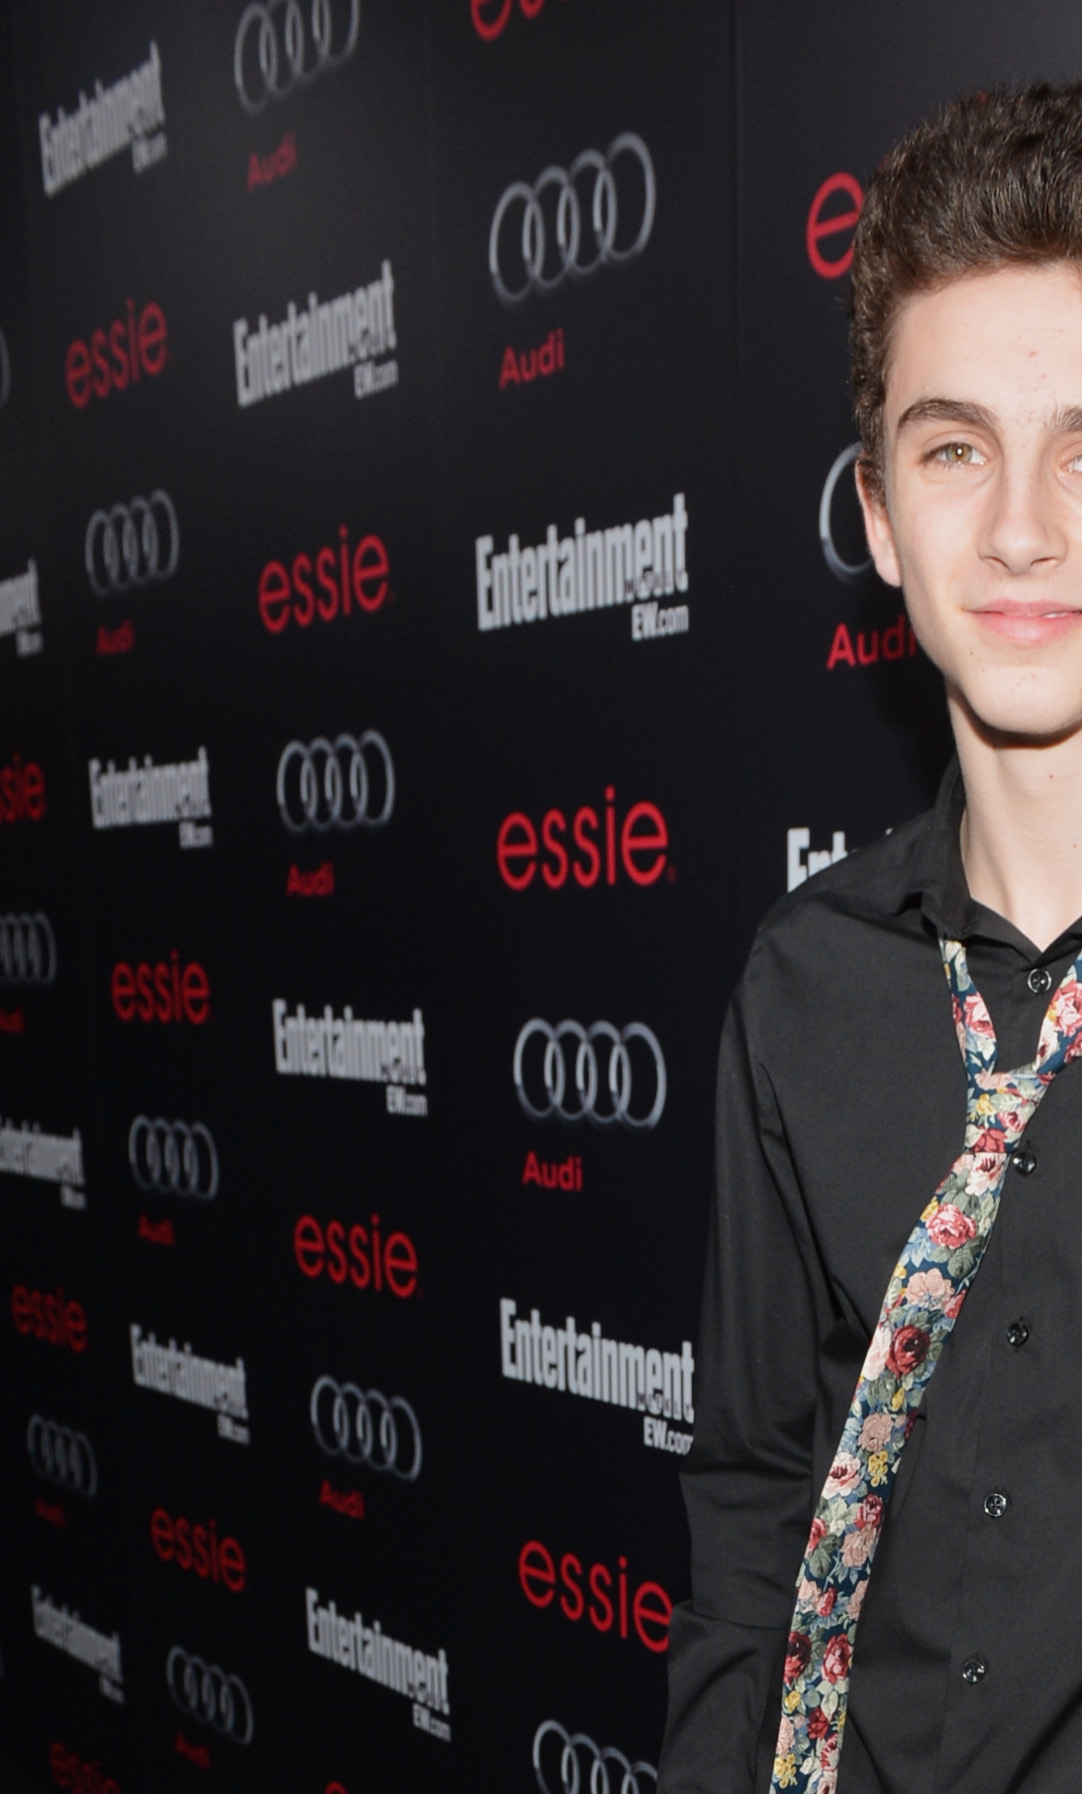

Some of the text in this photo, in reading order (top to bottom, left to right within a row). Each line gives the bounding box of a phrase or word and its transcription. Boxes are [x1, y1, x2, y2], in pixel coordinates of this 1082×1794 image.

[246, 133, 297, 191] Audi
[66, 298, 169, 408] essie
[500, 329, 565, 388] Audi
[258, 525, 389, 634] essie
[475, 493, 689, 631] Entertainment
[497, 786, 668, 891] essie
[111, 950, 211, 1025] essie
[522, 1151, 583, 1192] Audi
[293, 1213, 419, 1299] essie
[500, 1298, 695, 1424] Entertainment
[150, 1508, 247, 1593] essie
[518, 1540, 673, 1653] essie
